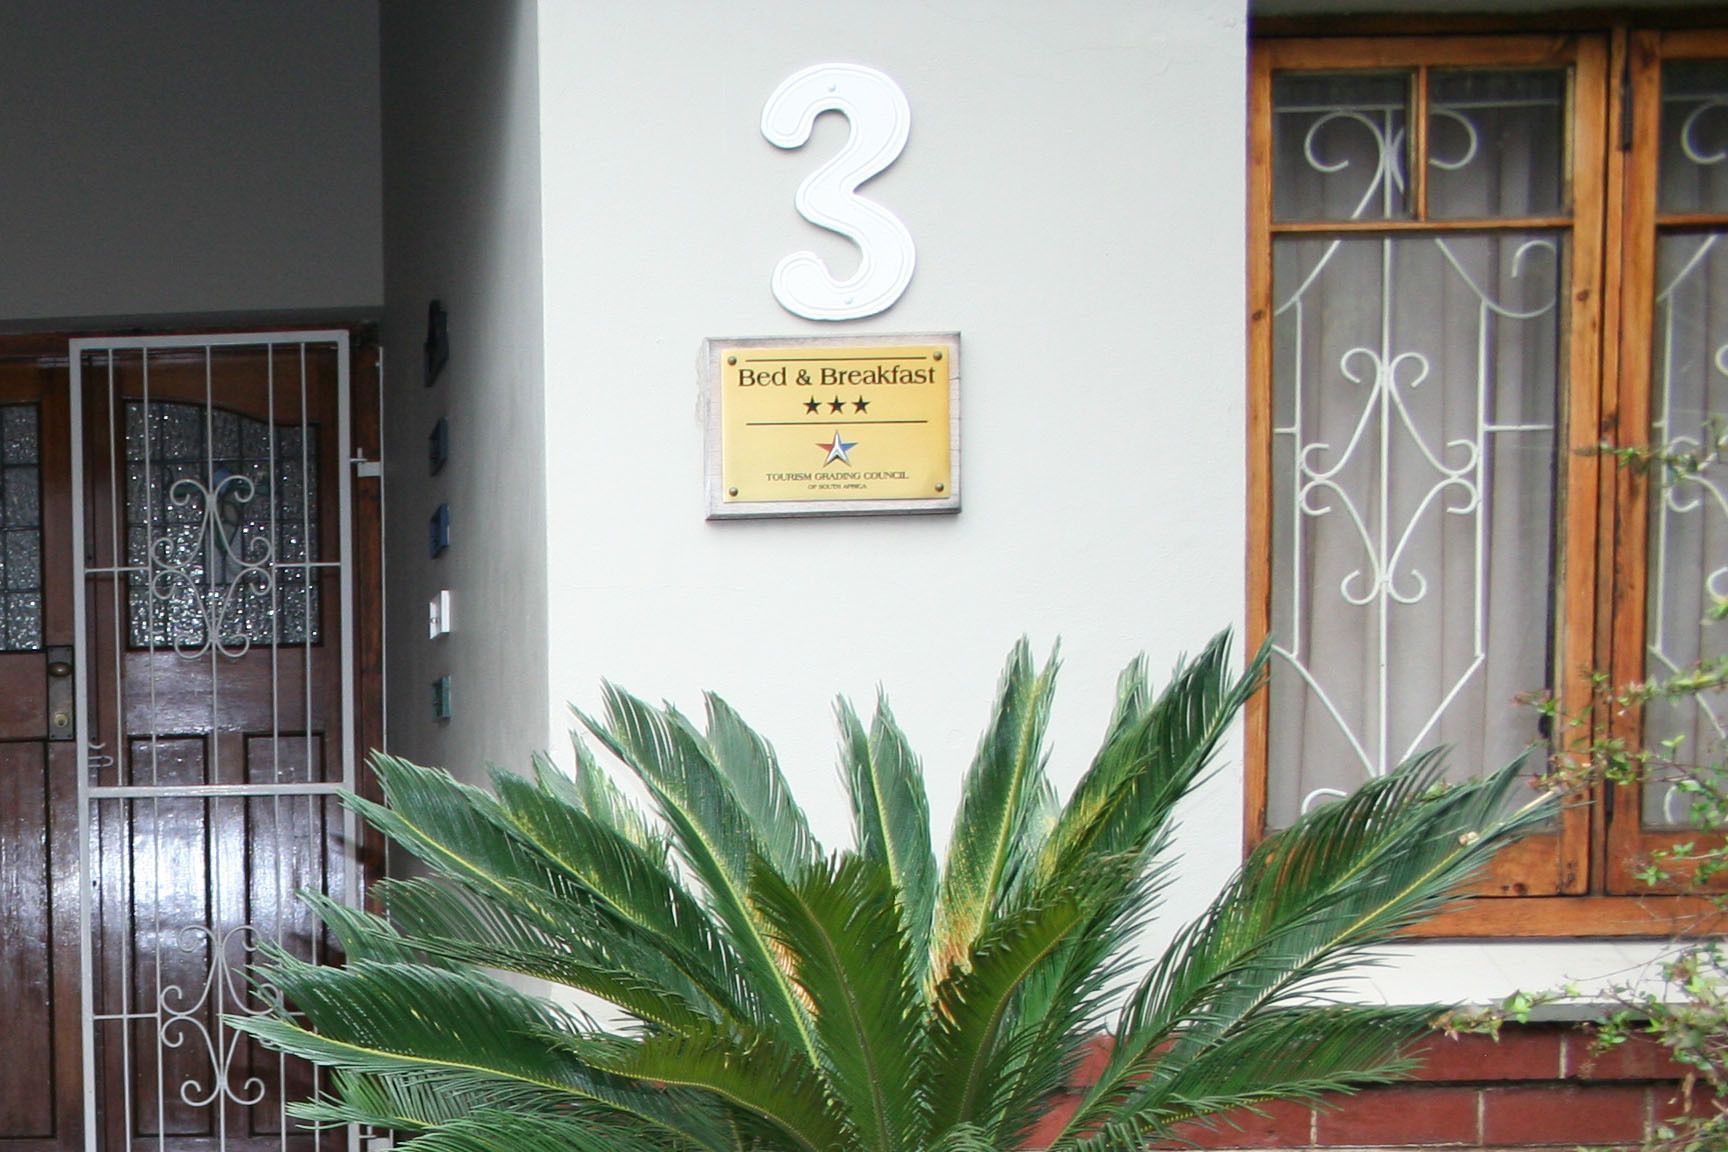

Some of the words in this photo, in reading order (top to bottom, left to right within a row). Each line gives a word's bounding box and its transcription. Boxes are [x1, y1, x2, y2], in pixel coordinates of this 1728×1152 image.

[760, 62, 916, 321] 3
[738, 367, 787, 386] Bed
[795, 369, 812, 385] &
[819, 365, 935, 385] Breakfast
[766, 473, 812, 481] TOURISM
[814, 472, 861, 480] GRADING
[863, 471, 909, 480] COUNCIL
